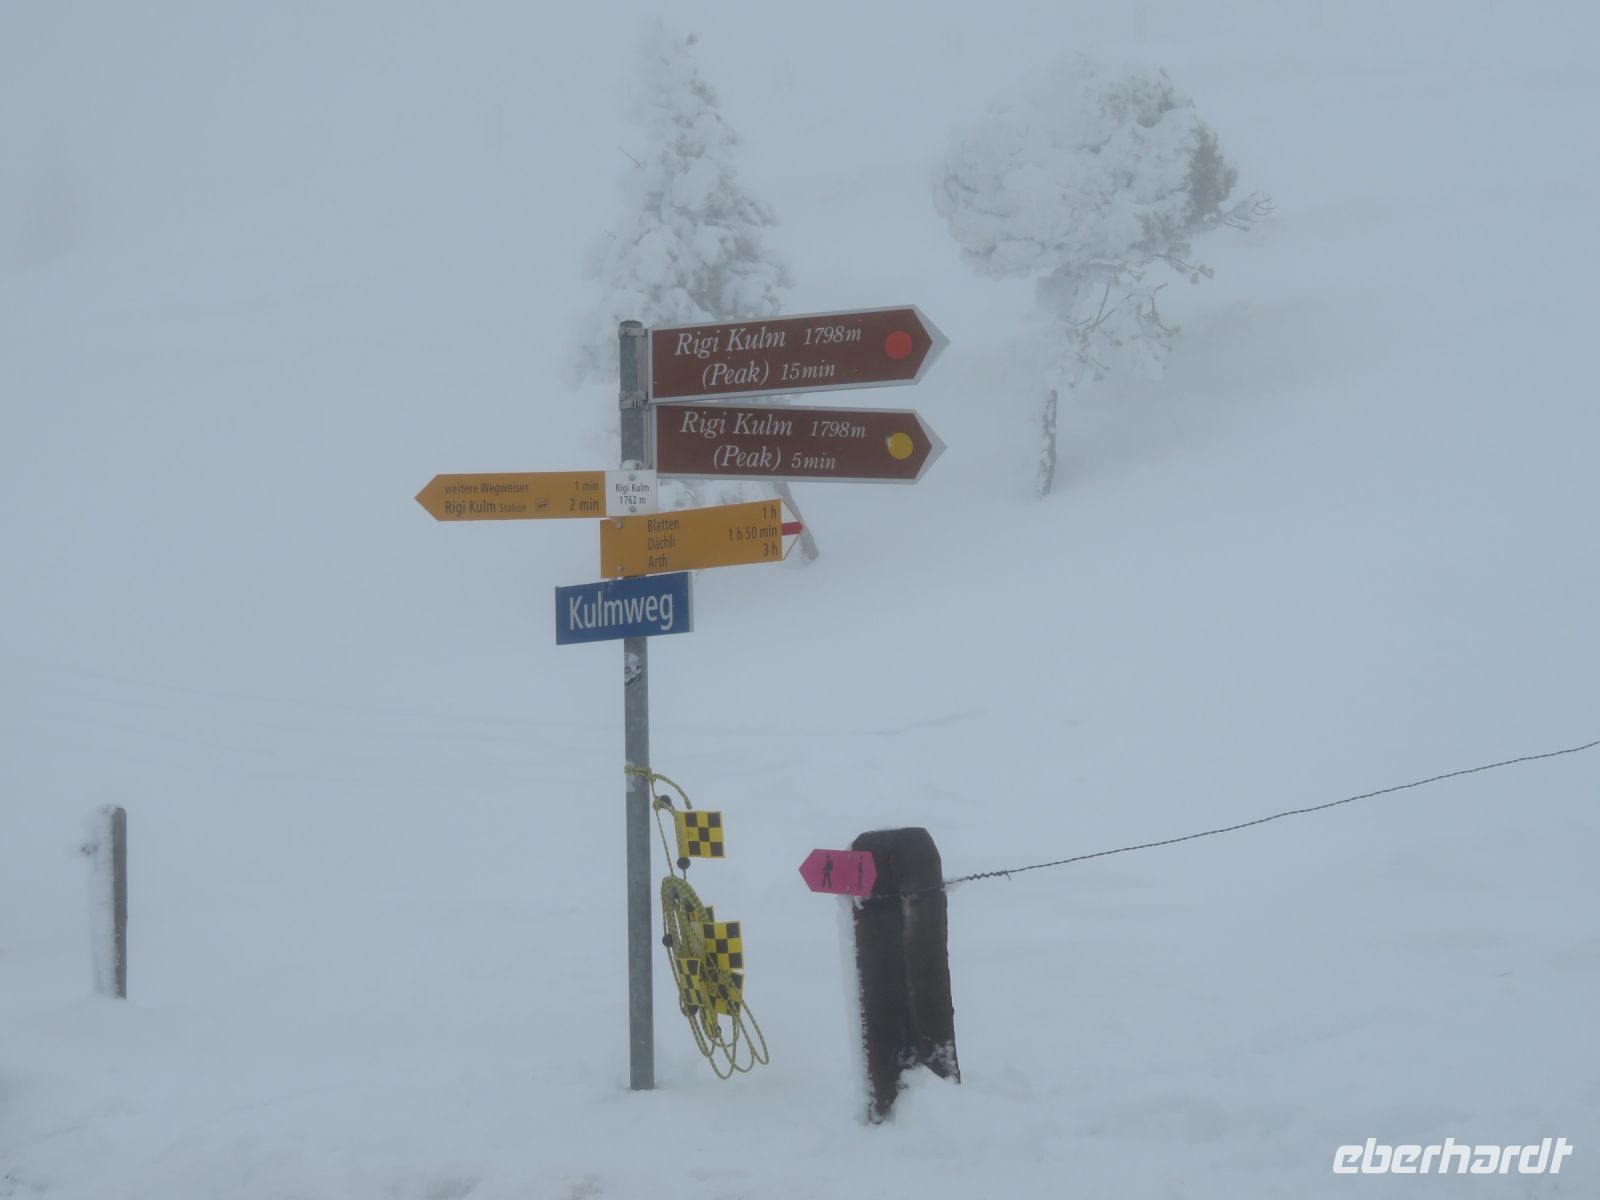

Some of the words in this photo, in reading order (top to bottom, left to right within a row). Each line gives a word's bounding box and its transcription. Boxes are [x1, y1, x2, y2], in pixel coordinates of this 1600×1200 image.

[674, 330, 720, 358] Rigi
[725, 327, 786, 351] Kulm
[702, 360, 769, 389] (Peak)
[680, 411, 727, 438] Rigi
[732, 413, 792, 436] Kulm
[713, 445, 782, 471] (Peak)
[444, 484, 479, 494] weitere
[480, 482, 529, 496] Wegweiser
[575, 481, 580, 491] 1
[582, 481, 599, 491] min
[615, 483, 629, 494] Rigi
[631, 483, 650, 492] Kulm
[619, 496, 637, 505] 1762
[445, 500, 466, 517] Rigi
[469, 500, 496, 513] Kulm
[500, 503, 527, 513] Station
[569, 500, 575, 511] 2
[579, 499, 599, 511] min
[647, 518, 680, 533] Blatten
[763, 507, 767, 520] 1
[771, 506, 777, 519] h
[729, 529, 733, 541] 1
[736, 527, 743, 540] h
[745, 526, 757, 540] 50
[760, 525, 777, 538] min
[648, 556, 668, 568] Arth
[763, 543, 769, 556] 3
[772, 543, 778, 555] h
[569, 591, 673, 631] Kulmweg
